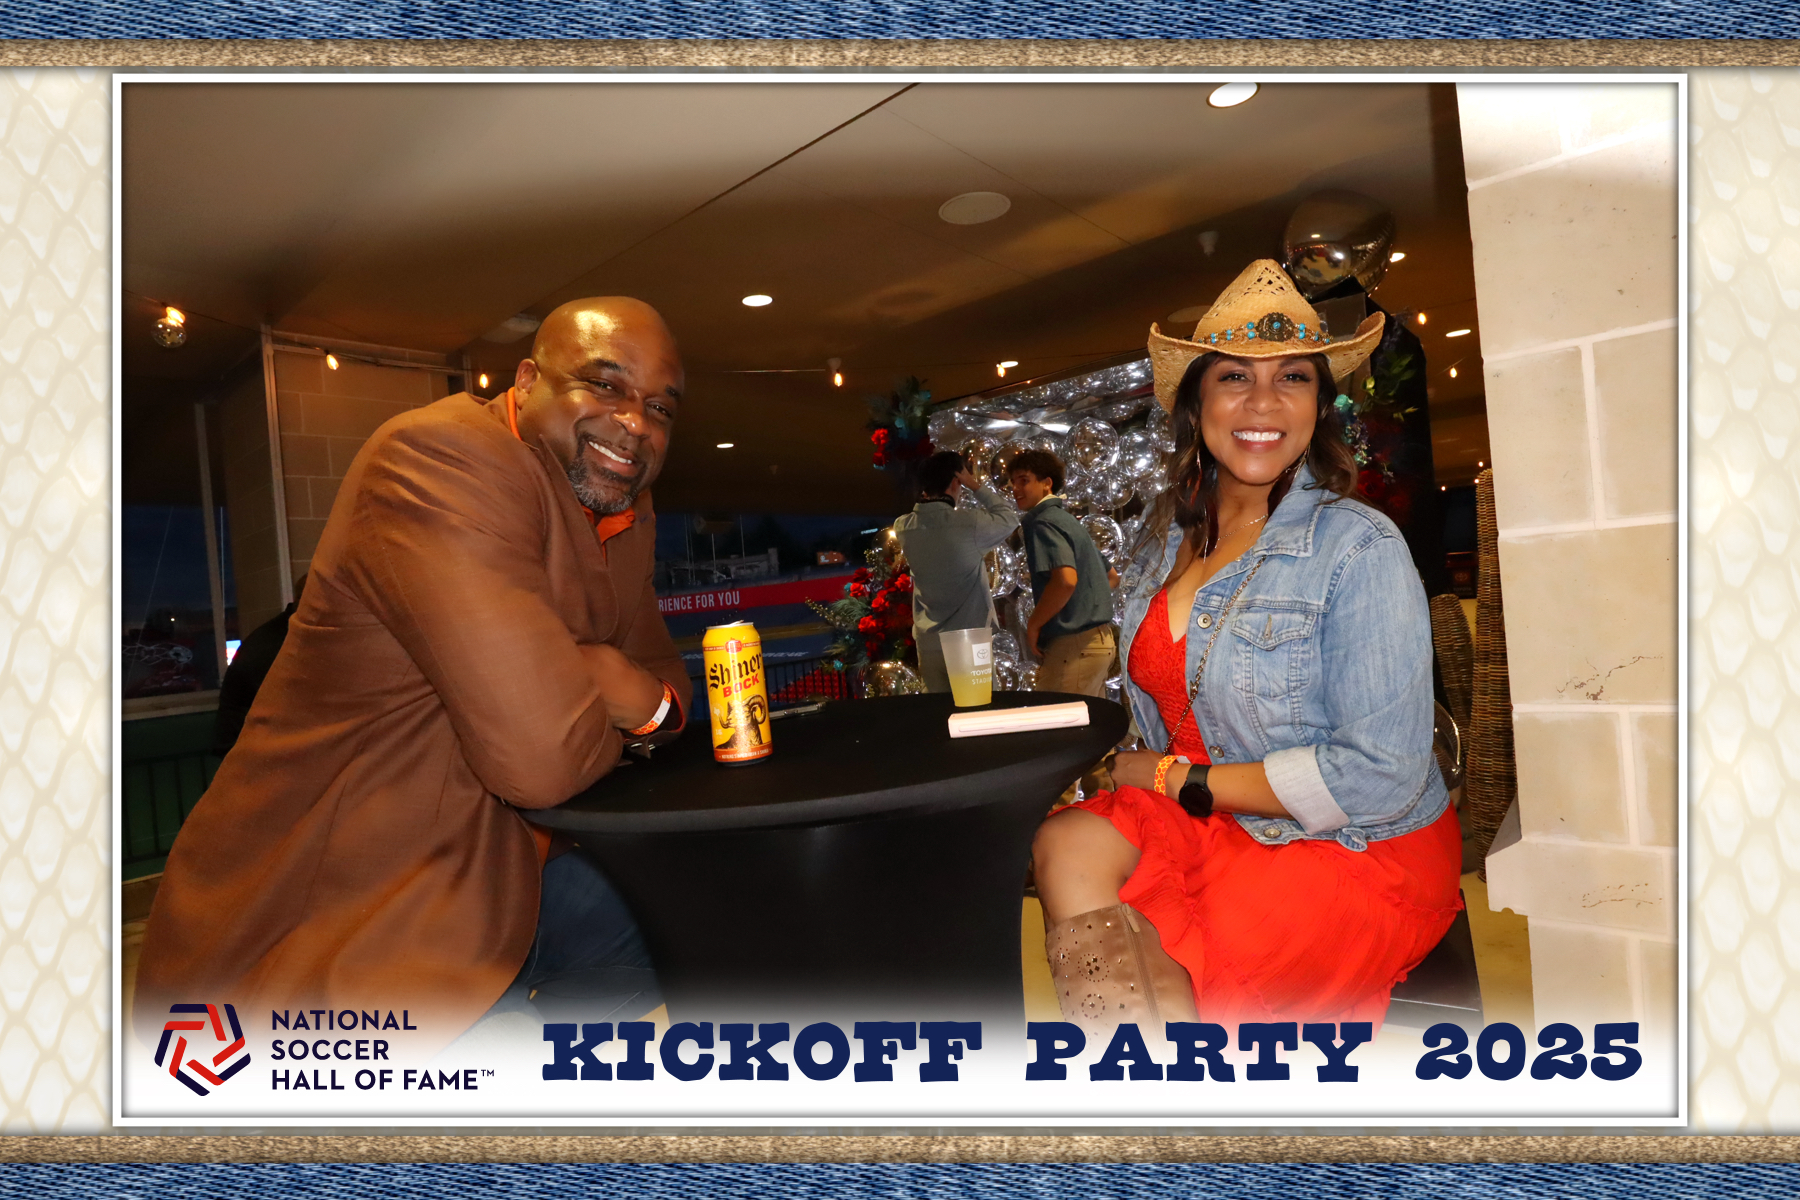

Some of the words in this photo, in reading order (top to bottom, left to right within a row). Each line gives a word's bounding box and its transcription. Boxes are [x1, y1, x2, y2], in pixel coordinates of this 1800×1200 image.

[695, 593, 715, 609] FOR
[717, 590, 740, 607] YOU
[709, 652, 762, 691] Shiner
[723, 673, 760, 698] BOCK
